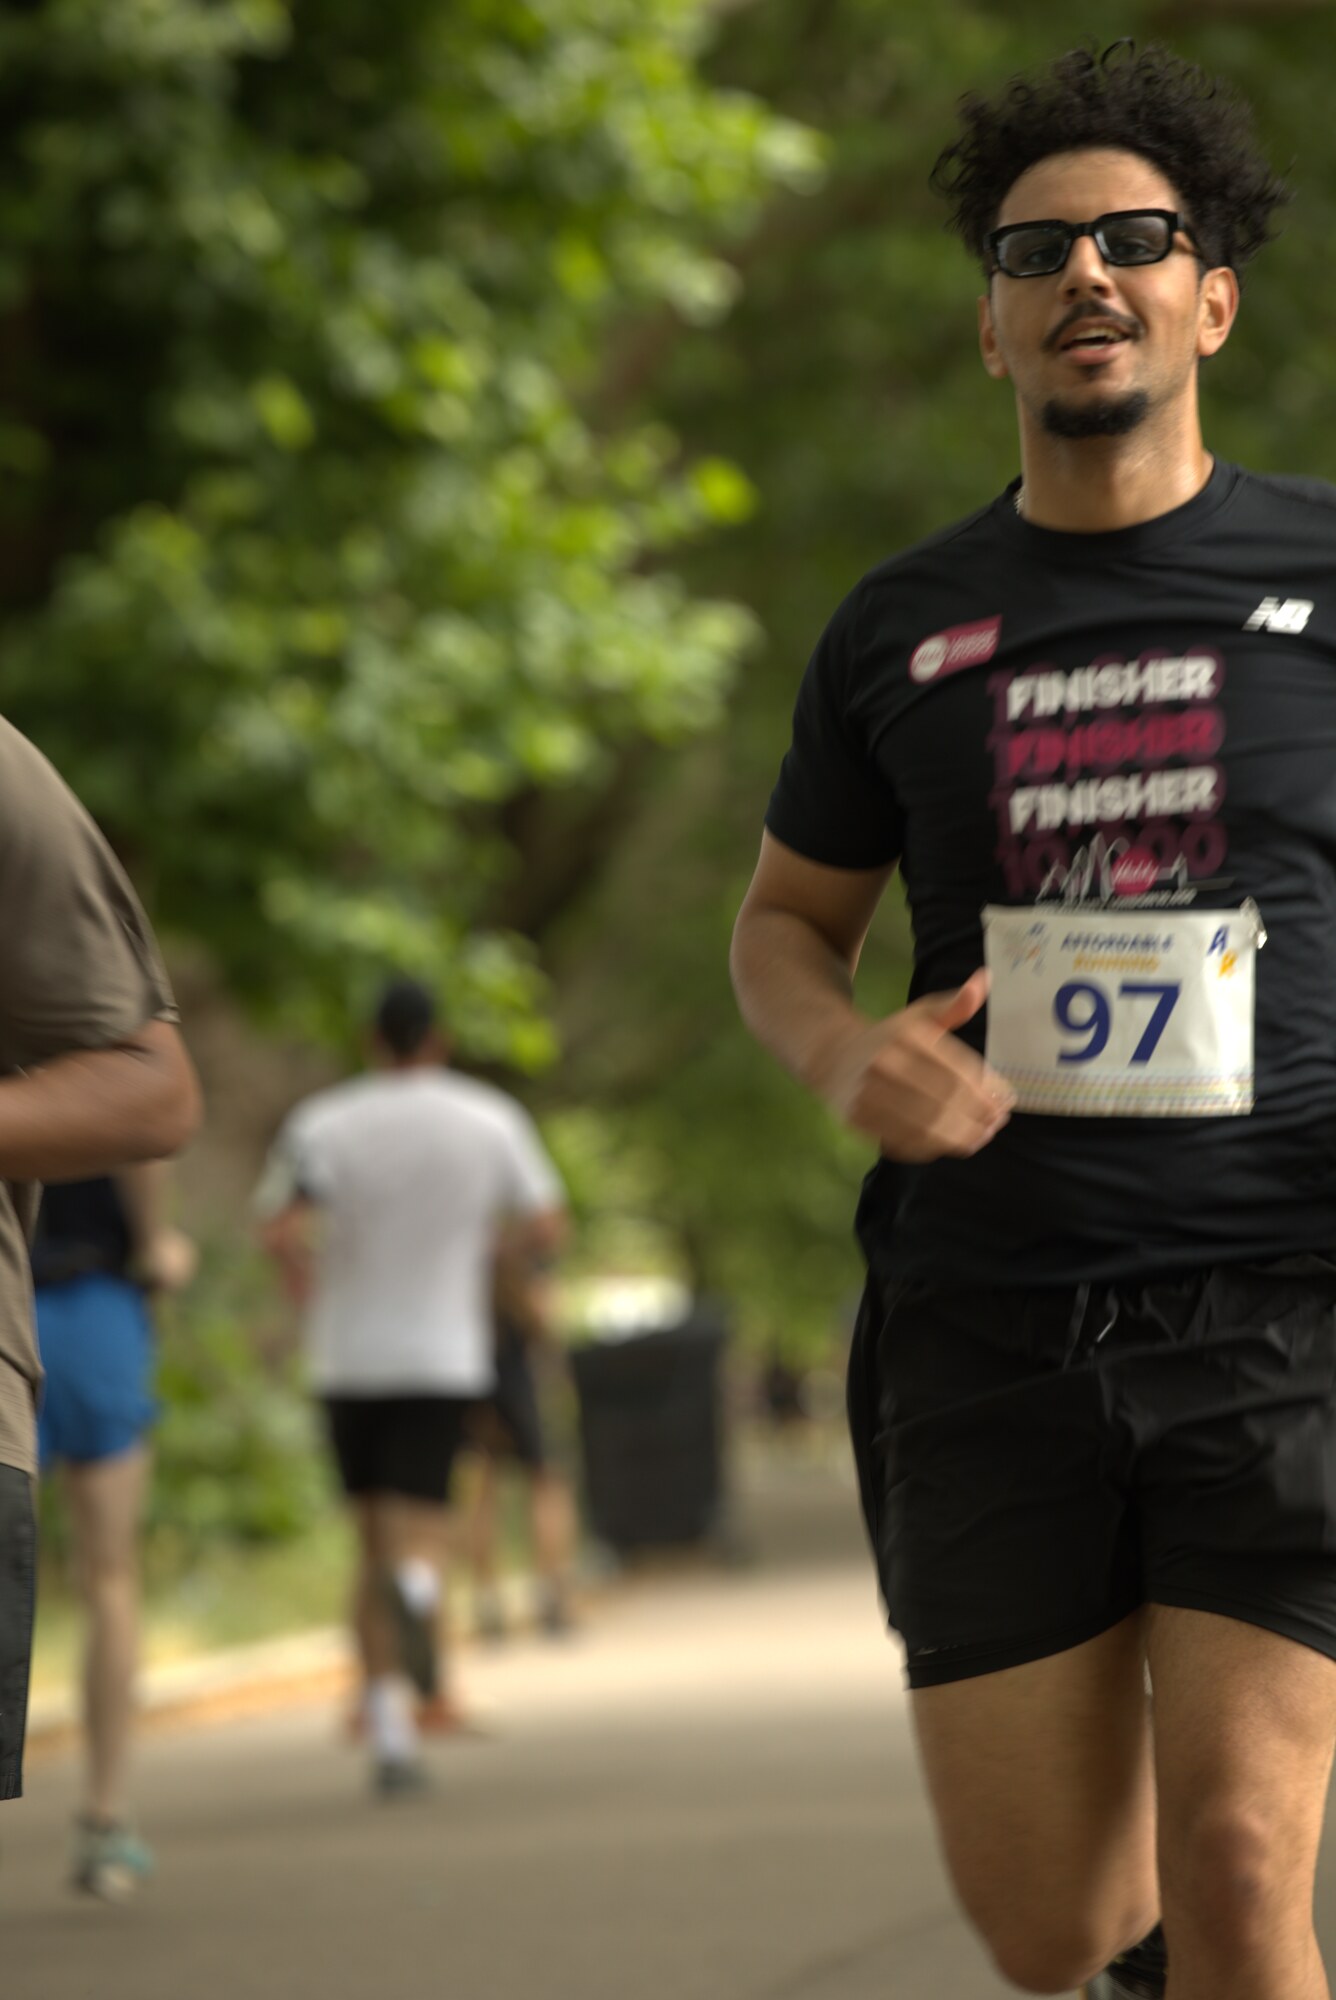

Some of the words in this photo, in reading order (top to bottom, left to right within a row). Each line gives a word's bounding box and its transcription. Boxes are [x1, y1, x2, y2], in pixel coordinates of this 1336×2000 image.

[1006, 655, 1217, 721] FINISHER
[1009, 765, 1218, 834] FINISHER
[1053, 978, 1182, 1067] 97
